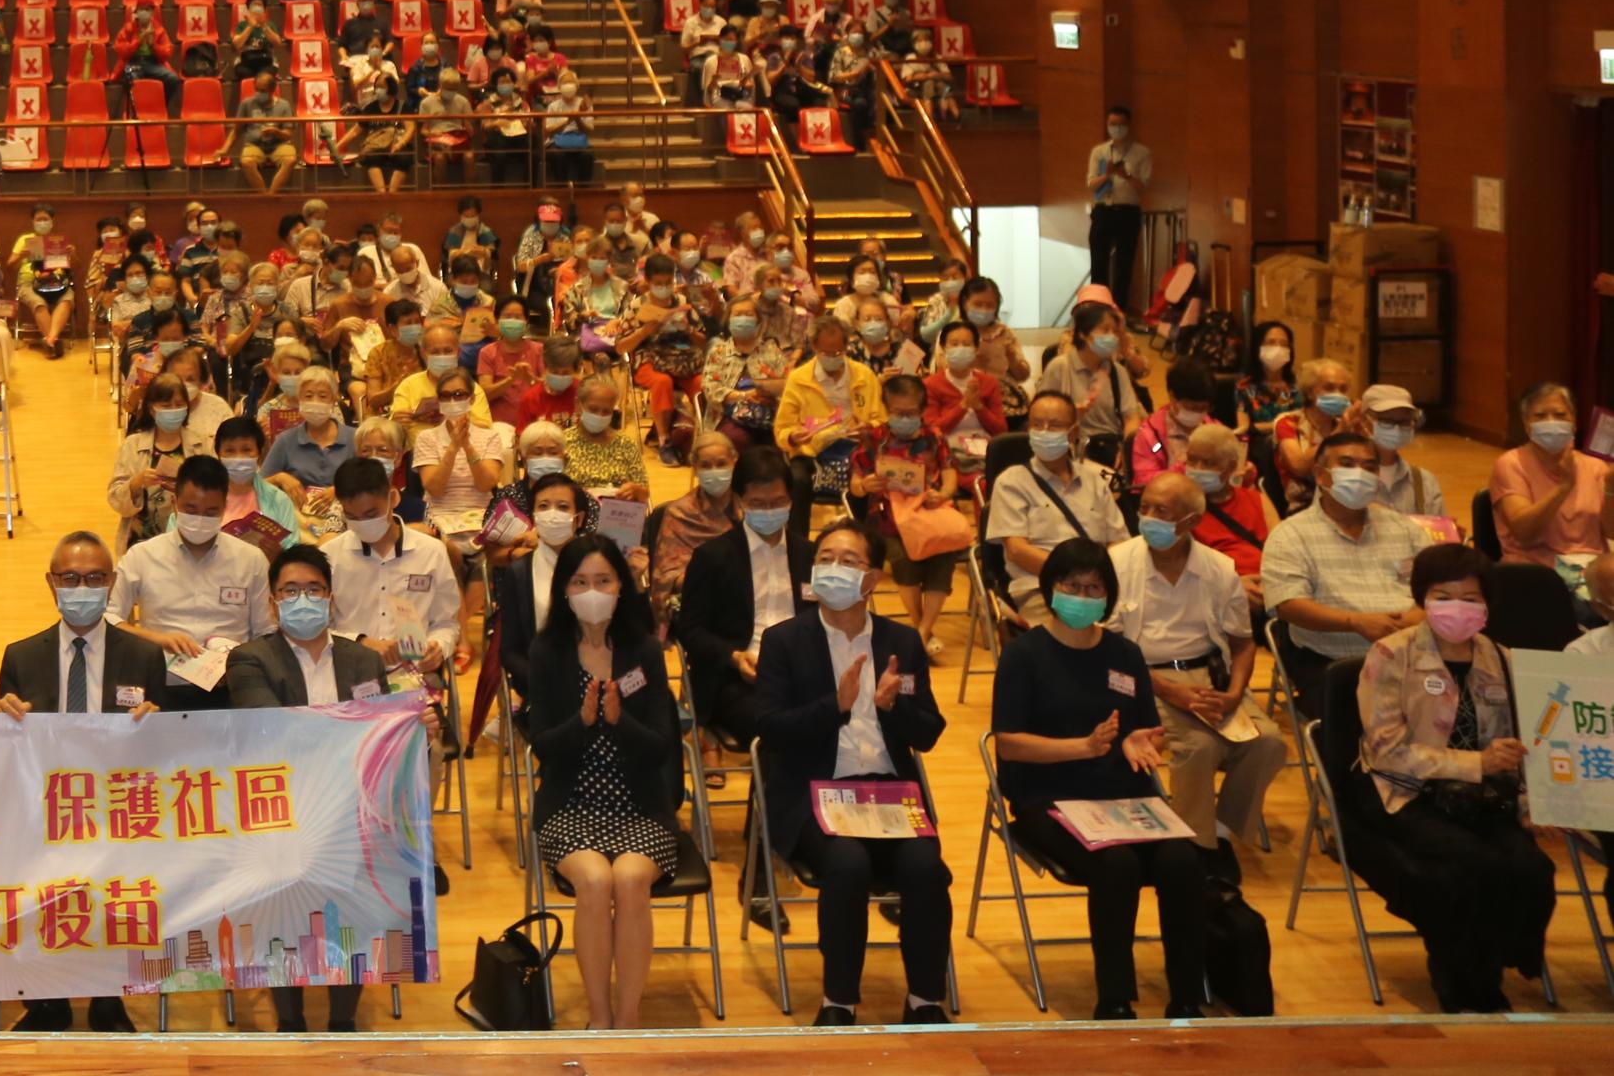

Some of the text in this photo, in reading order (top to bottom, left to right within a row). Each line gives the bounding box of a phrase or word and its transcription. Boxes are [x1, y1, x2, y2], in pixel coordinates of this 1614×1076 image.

[1572, 701, 1614, 735] 防
[43, 762, 296, 843] 保護社區
